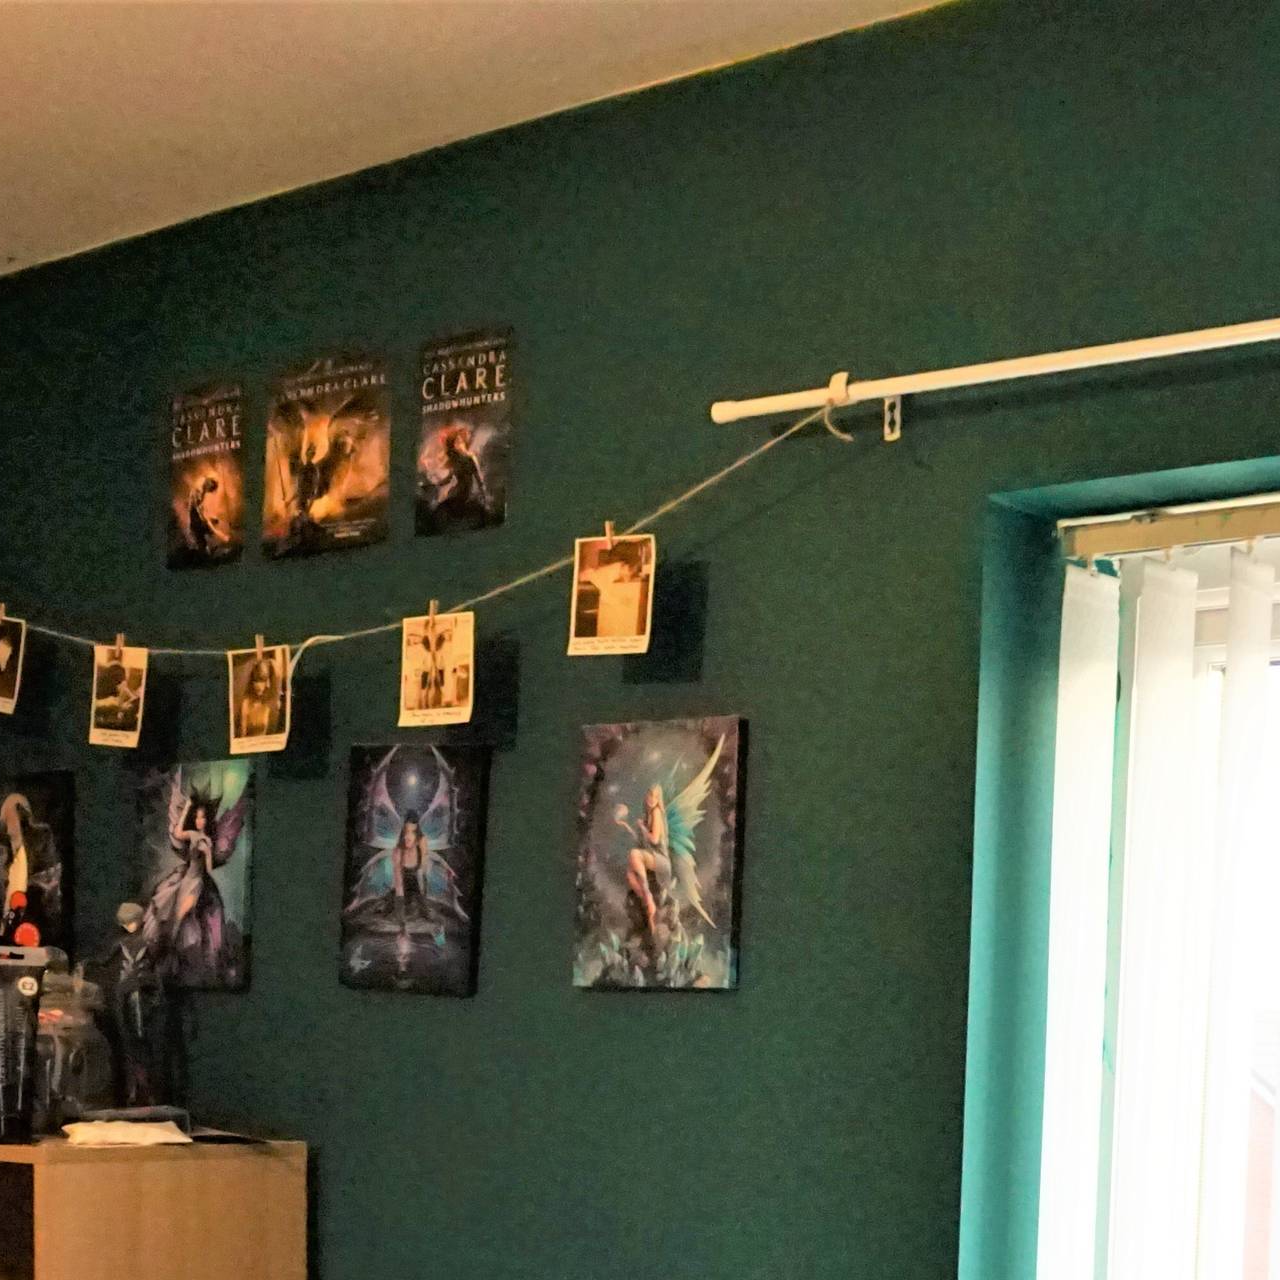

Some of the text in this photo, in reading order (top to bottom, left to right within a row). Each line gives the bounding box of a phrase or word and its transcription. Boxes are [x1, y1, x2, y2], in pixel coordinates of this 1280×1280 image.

[423, 350, 506, 375] CASSANDRA
[422, 364, 506, 400] CLARE
[422, 391, 506, 414] SHADOWHUNTERS
[172, 414, 241, 448] CLARE
